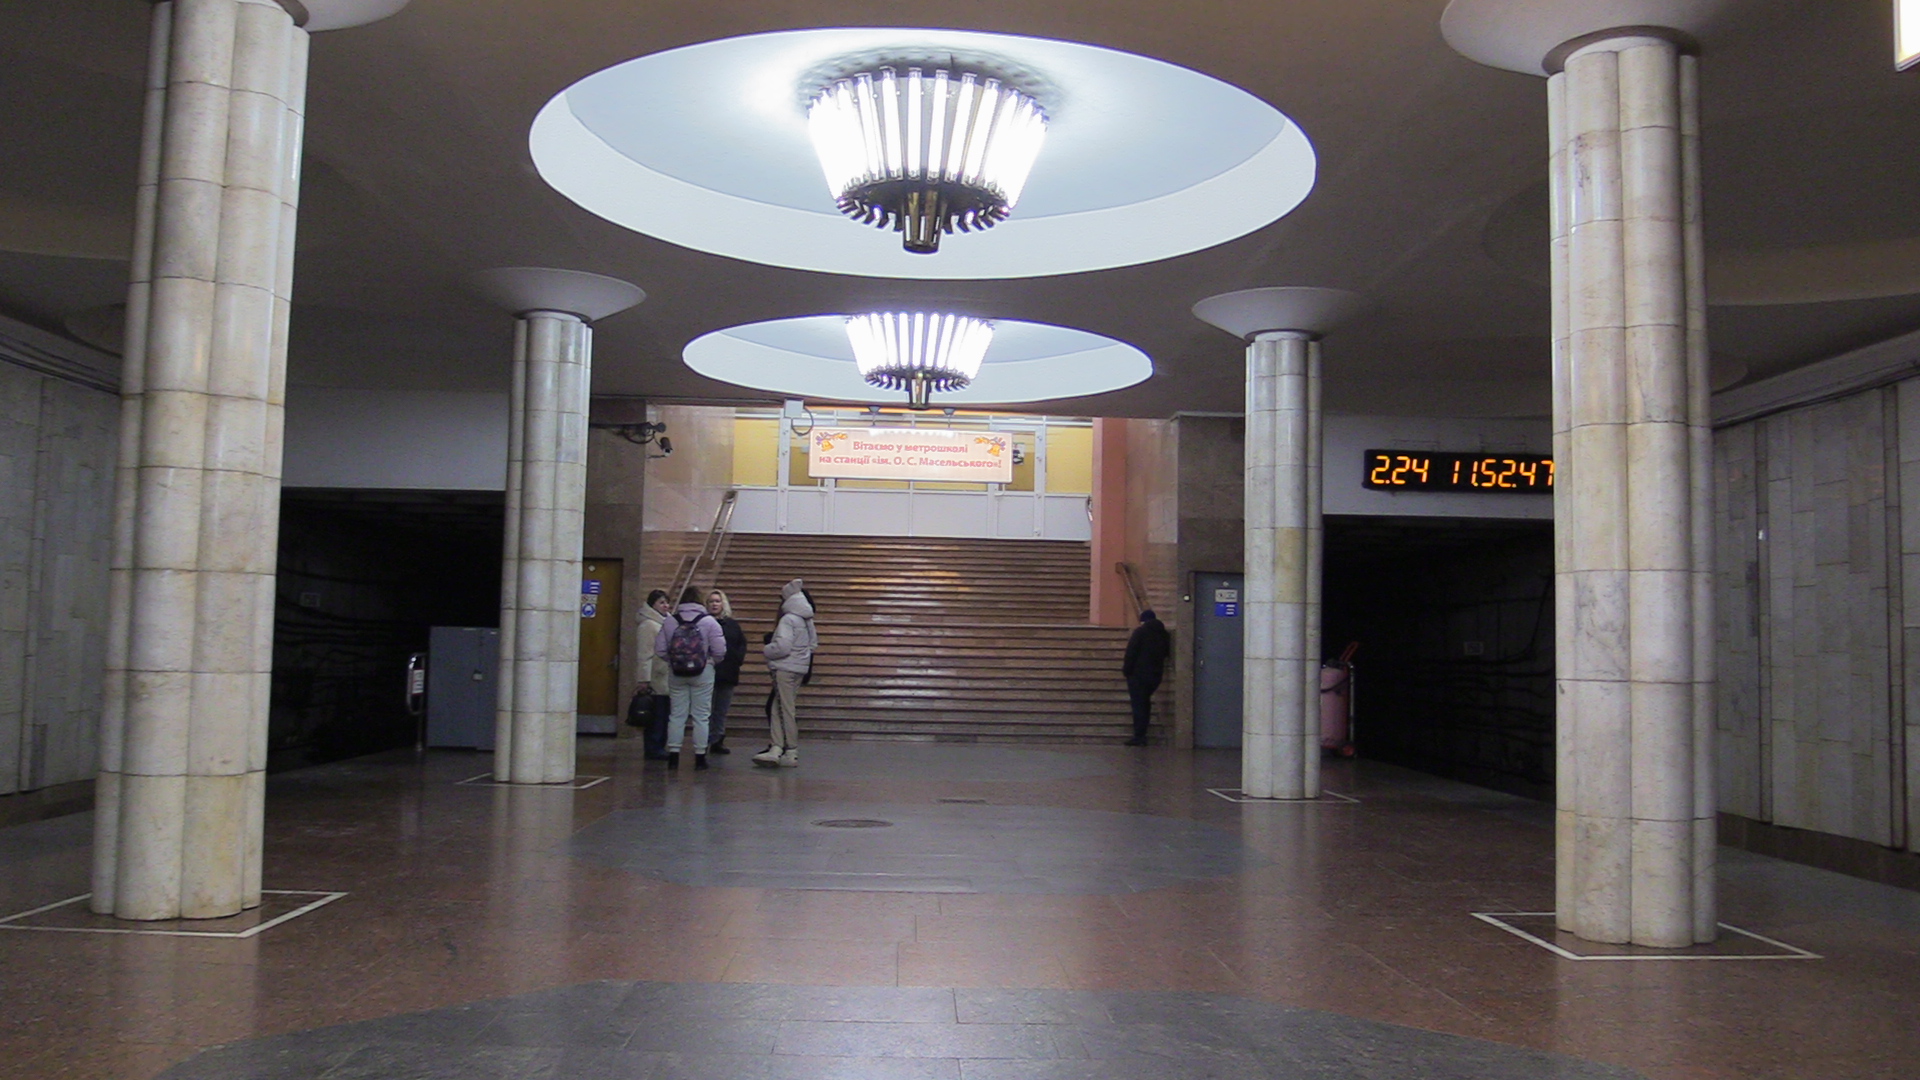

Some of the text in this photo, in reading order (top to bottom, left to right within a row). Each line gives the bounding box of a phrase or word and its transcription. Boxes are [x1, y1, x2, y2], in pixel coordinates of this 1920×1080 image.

[853, 441, 968, 454] Вітаємо у метрошколі
[833, 455, 870, 465] станції
[894, 456, 905, 465] О.
[907, 457, 917, 466] С.
